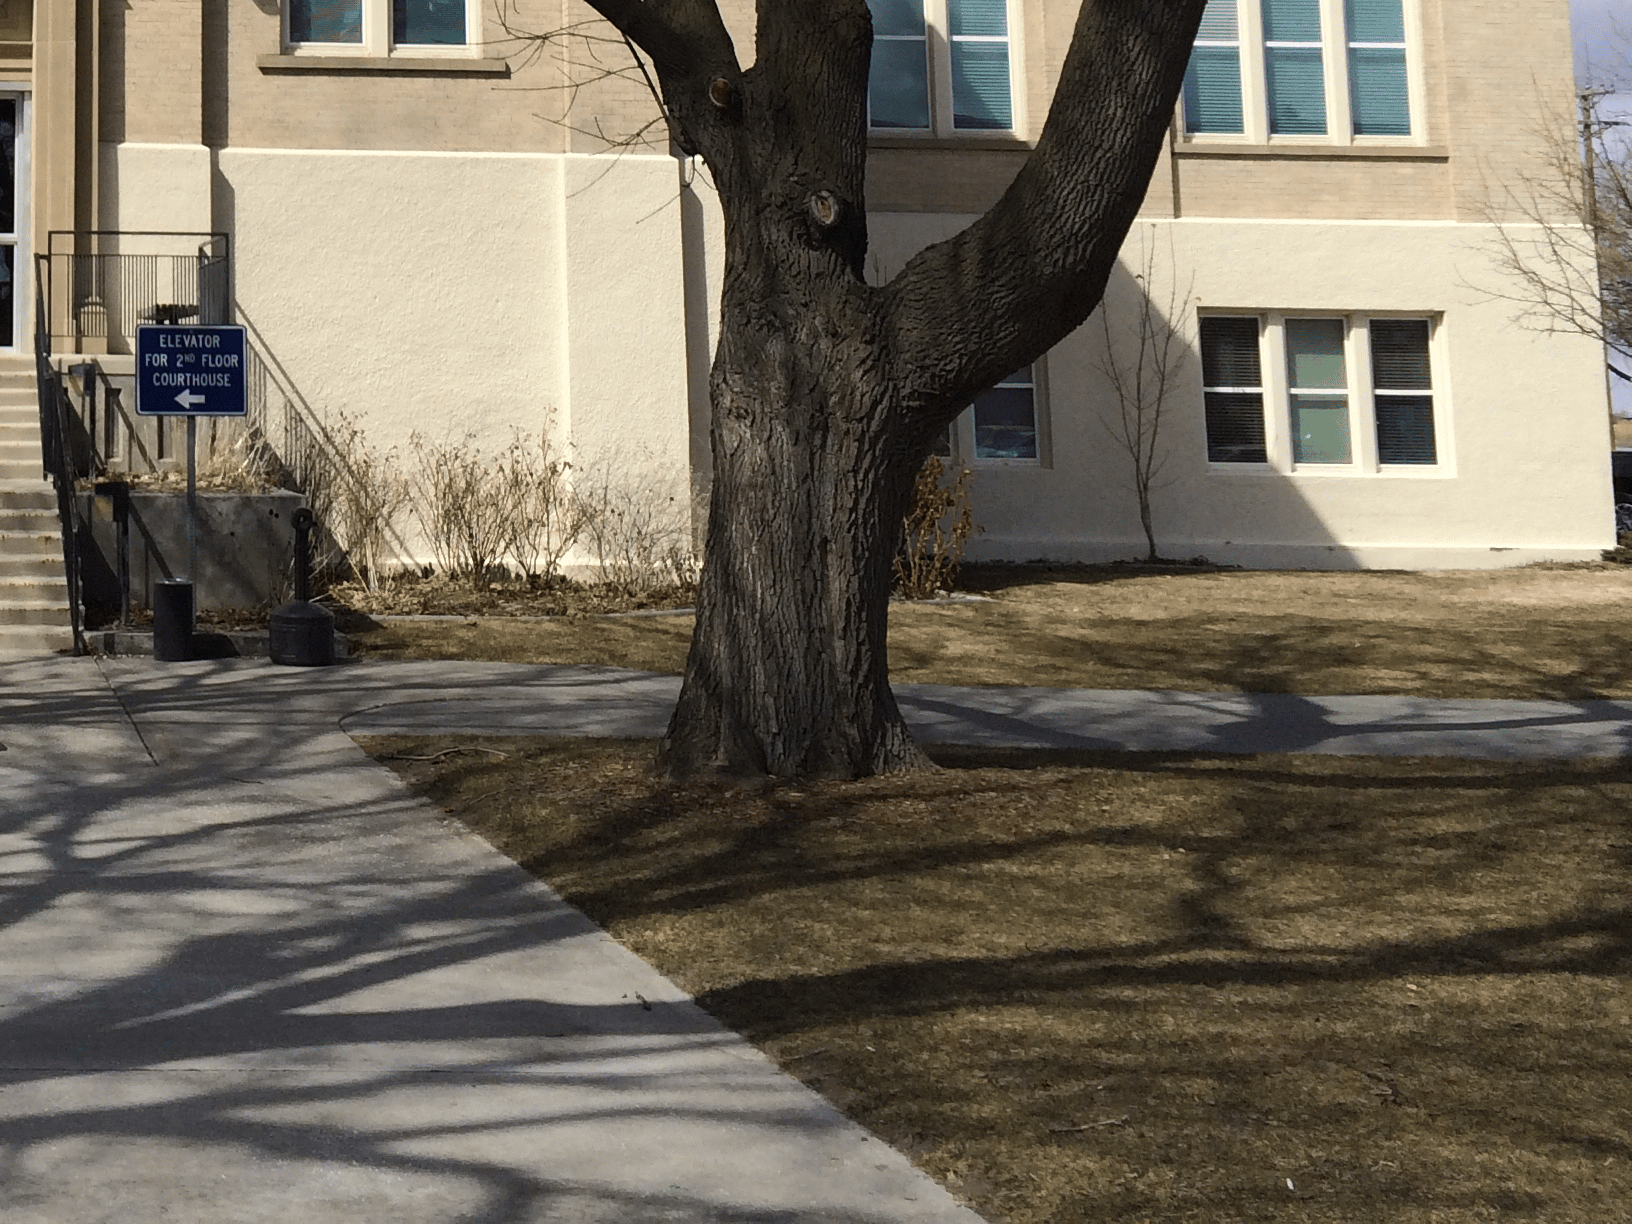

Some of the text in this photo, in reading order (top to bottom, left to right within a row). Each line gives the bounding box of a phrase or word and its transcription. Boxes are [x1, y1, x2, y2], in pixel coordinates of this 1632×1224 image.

[159, 334, 220, 348] ELEVATOR
[145, 353, 239, 368] FOR 2ND FLOOR
[152, 372, 231, 387] COURTHOUSE
